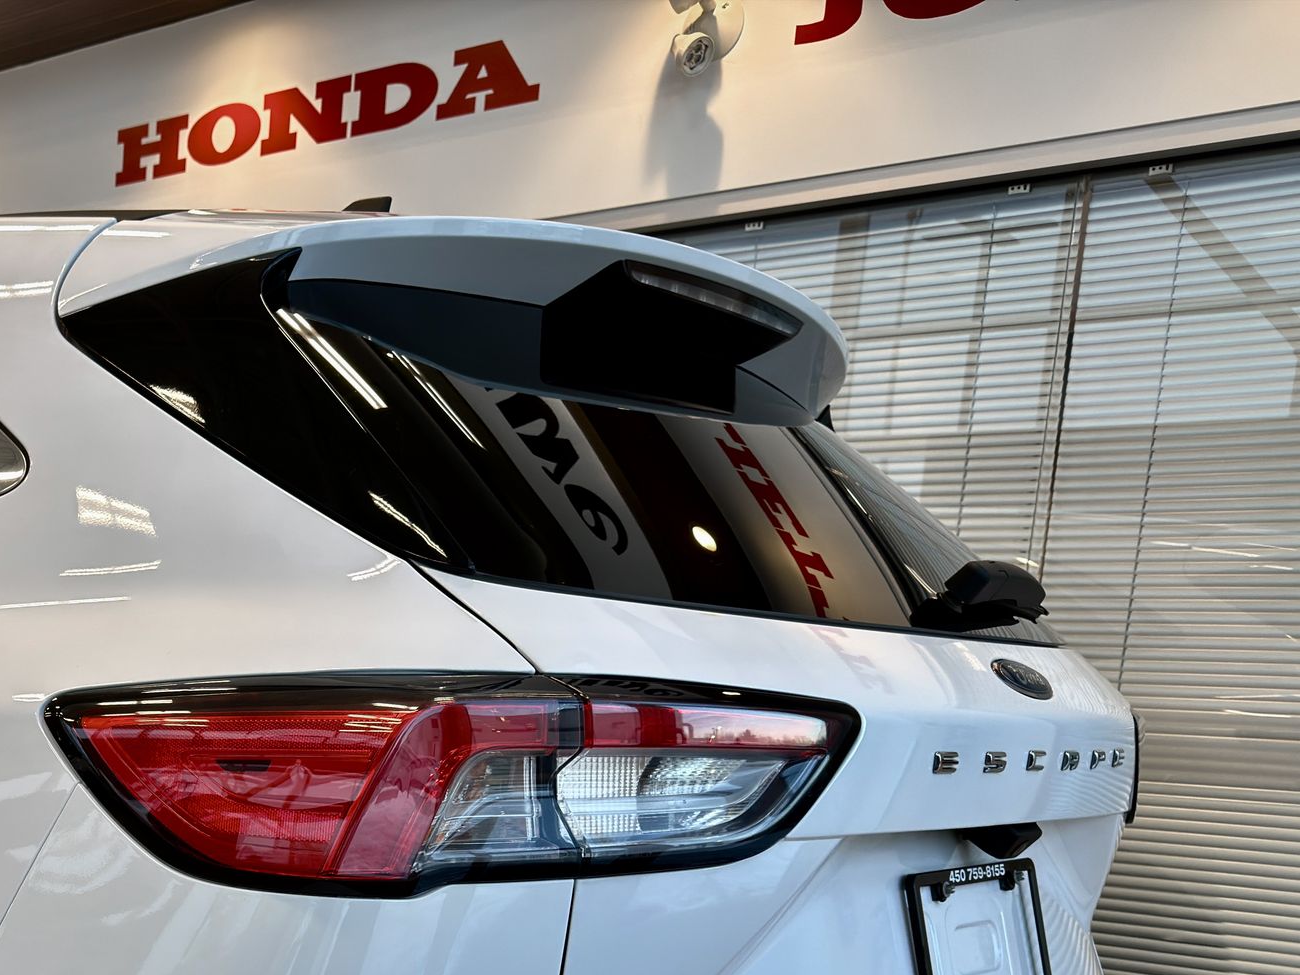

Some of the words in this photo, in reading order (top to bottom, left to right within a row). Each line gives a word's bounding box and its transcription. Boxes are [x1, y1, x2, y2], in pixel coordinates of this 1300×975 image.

[115, 40, 540, 187] HONDA
[932, 749, 1125, 774] ESCAPE
[949, 870, 966, 883] 450
[967, 864, 1006, 881] 759-8155
